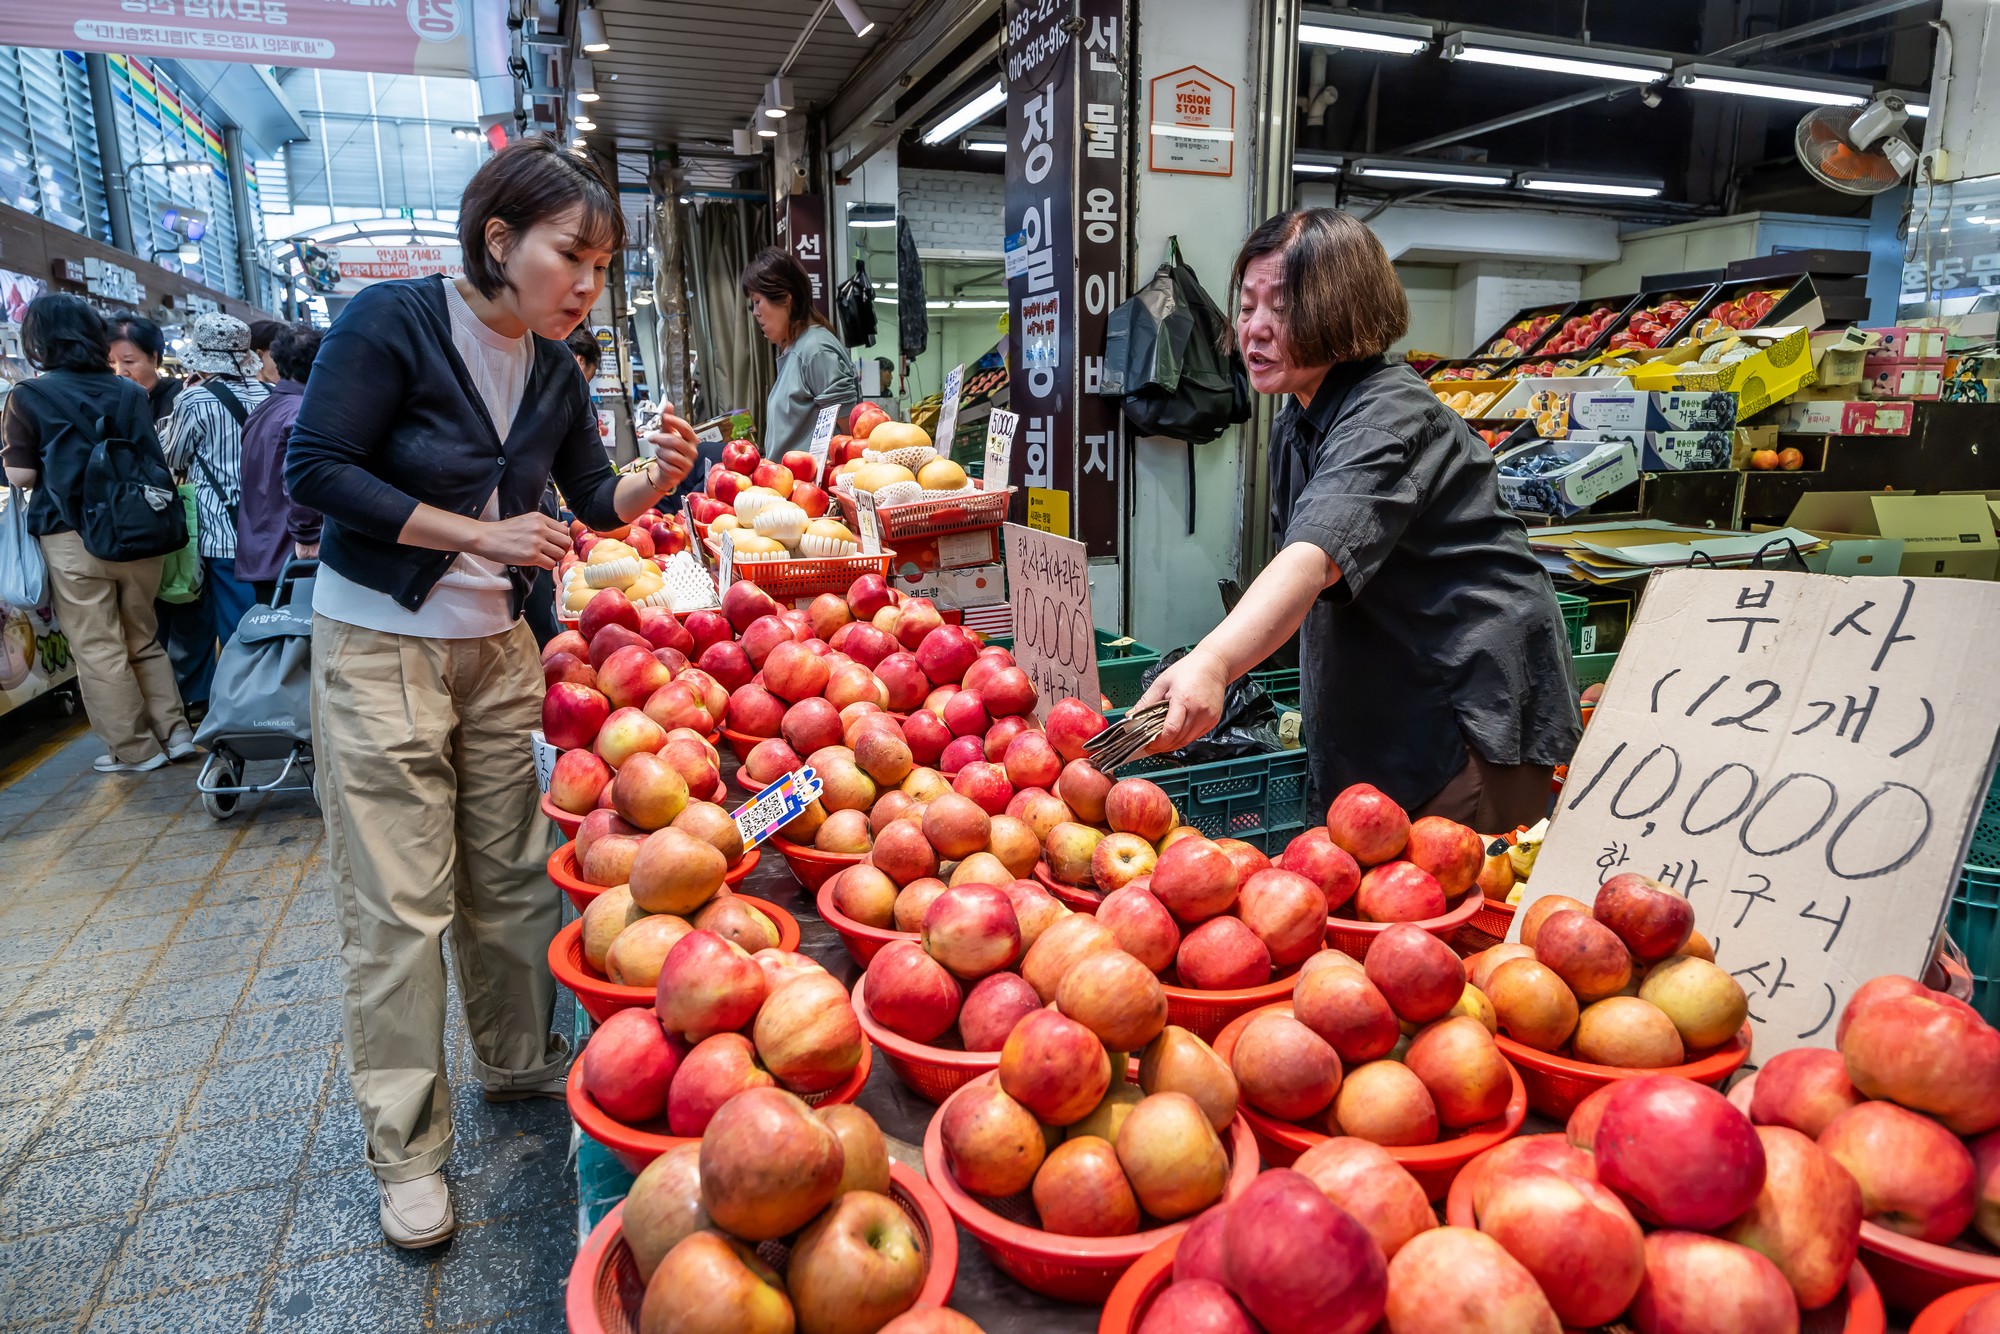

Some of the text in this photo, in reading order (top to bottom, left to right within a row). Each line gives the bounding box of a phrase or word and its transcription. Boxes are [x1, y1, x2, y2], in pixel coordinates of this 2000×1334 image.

[1176, 93, 1211, 105] VISION
[1175, 103, 1211, 116] STORE
[910, 587, 939, 599] 레드향
[1015, 587, 1089, 674] 10,000
[253, 719, 296, 728] LocknLock
[1568, 741, 1934, 880] 10,000
